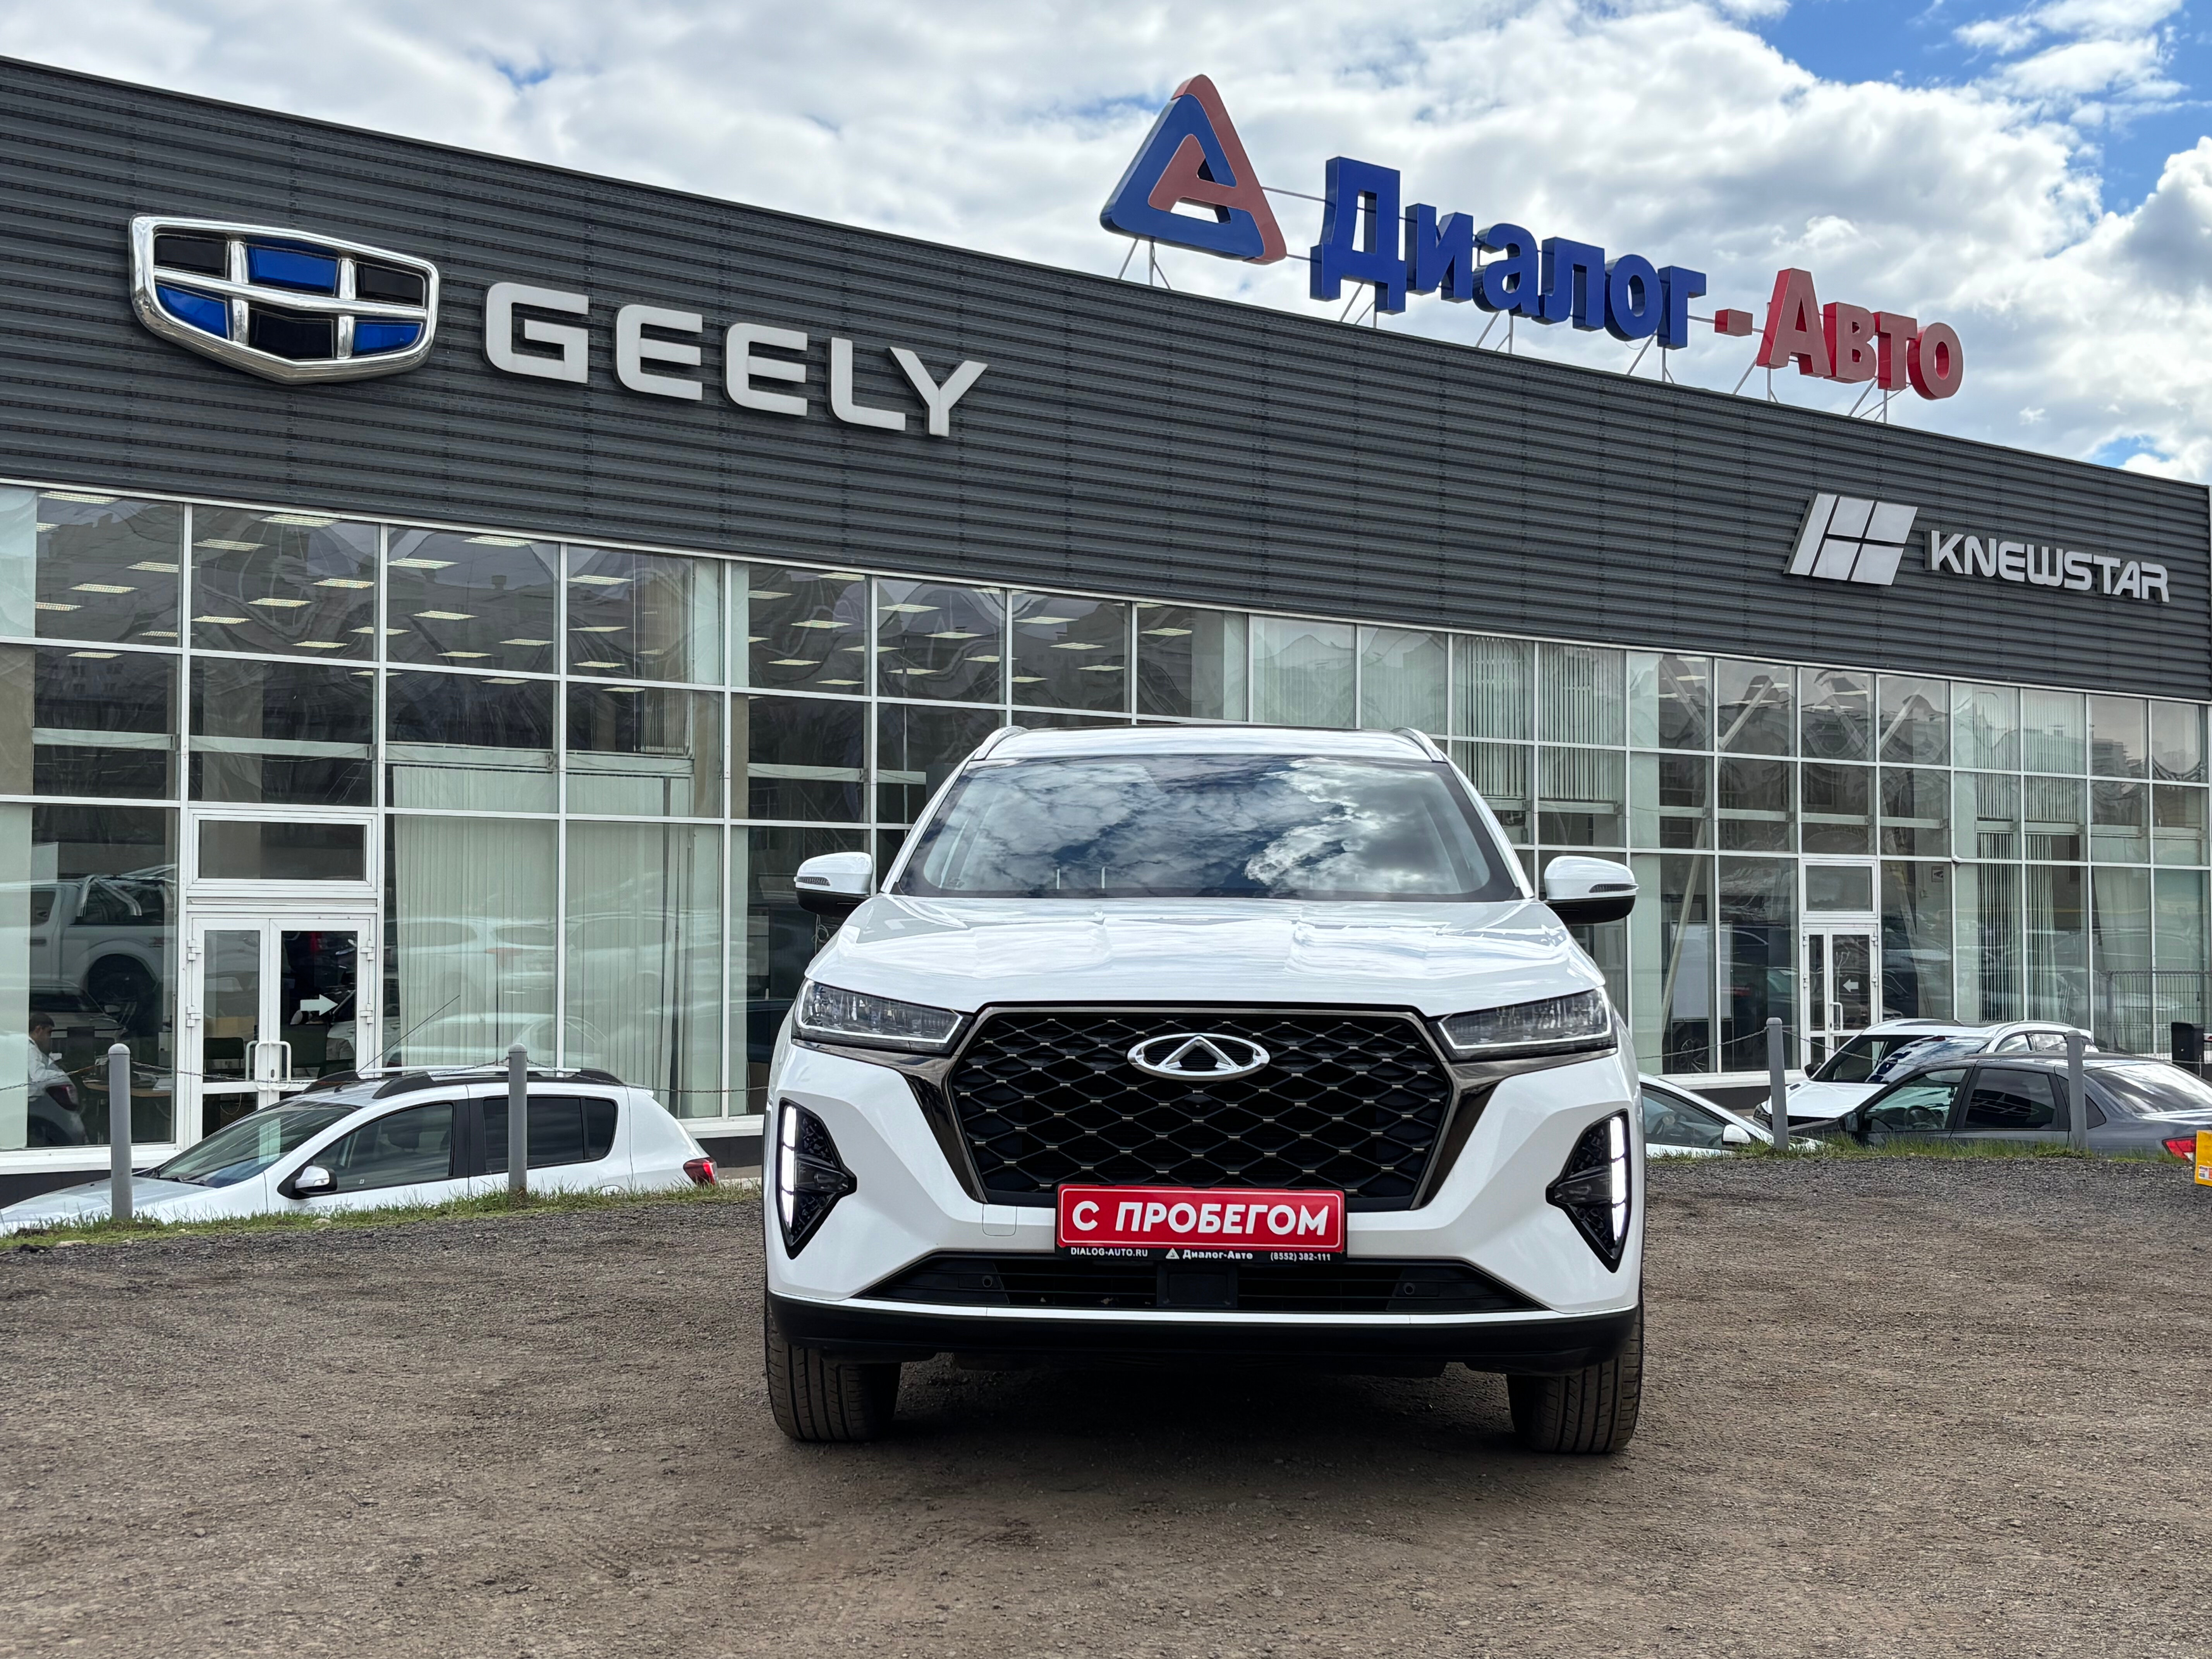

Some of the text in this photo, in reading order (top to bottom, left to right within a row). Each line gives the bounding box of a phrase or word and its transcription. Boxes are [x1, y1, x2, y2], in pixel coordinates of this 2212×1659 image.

[1310, 156, 1963, 400] Диалог-Авто
[482, 282, 988, 438] GEELY
[1929, 530, 2169, 603] KNEWSTAR
[1072, 1200, 1329, 1236] С ПРОБЕГОМ
[1070, 1247, 1148, 1257] DIALOG-AUTO.RU
[1182, 1249, 1253, 1260] Диалог-Авто
[1270, 1252, 1331, 1262] (8552) 382-111
